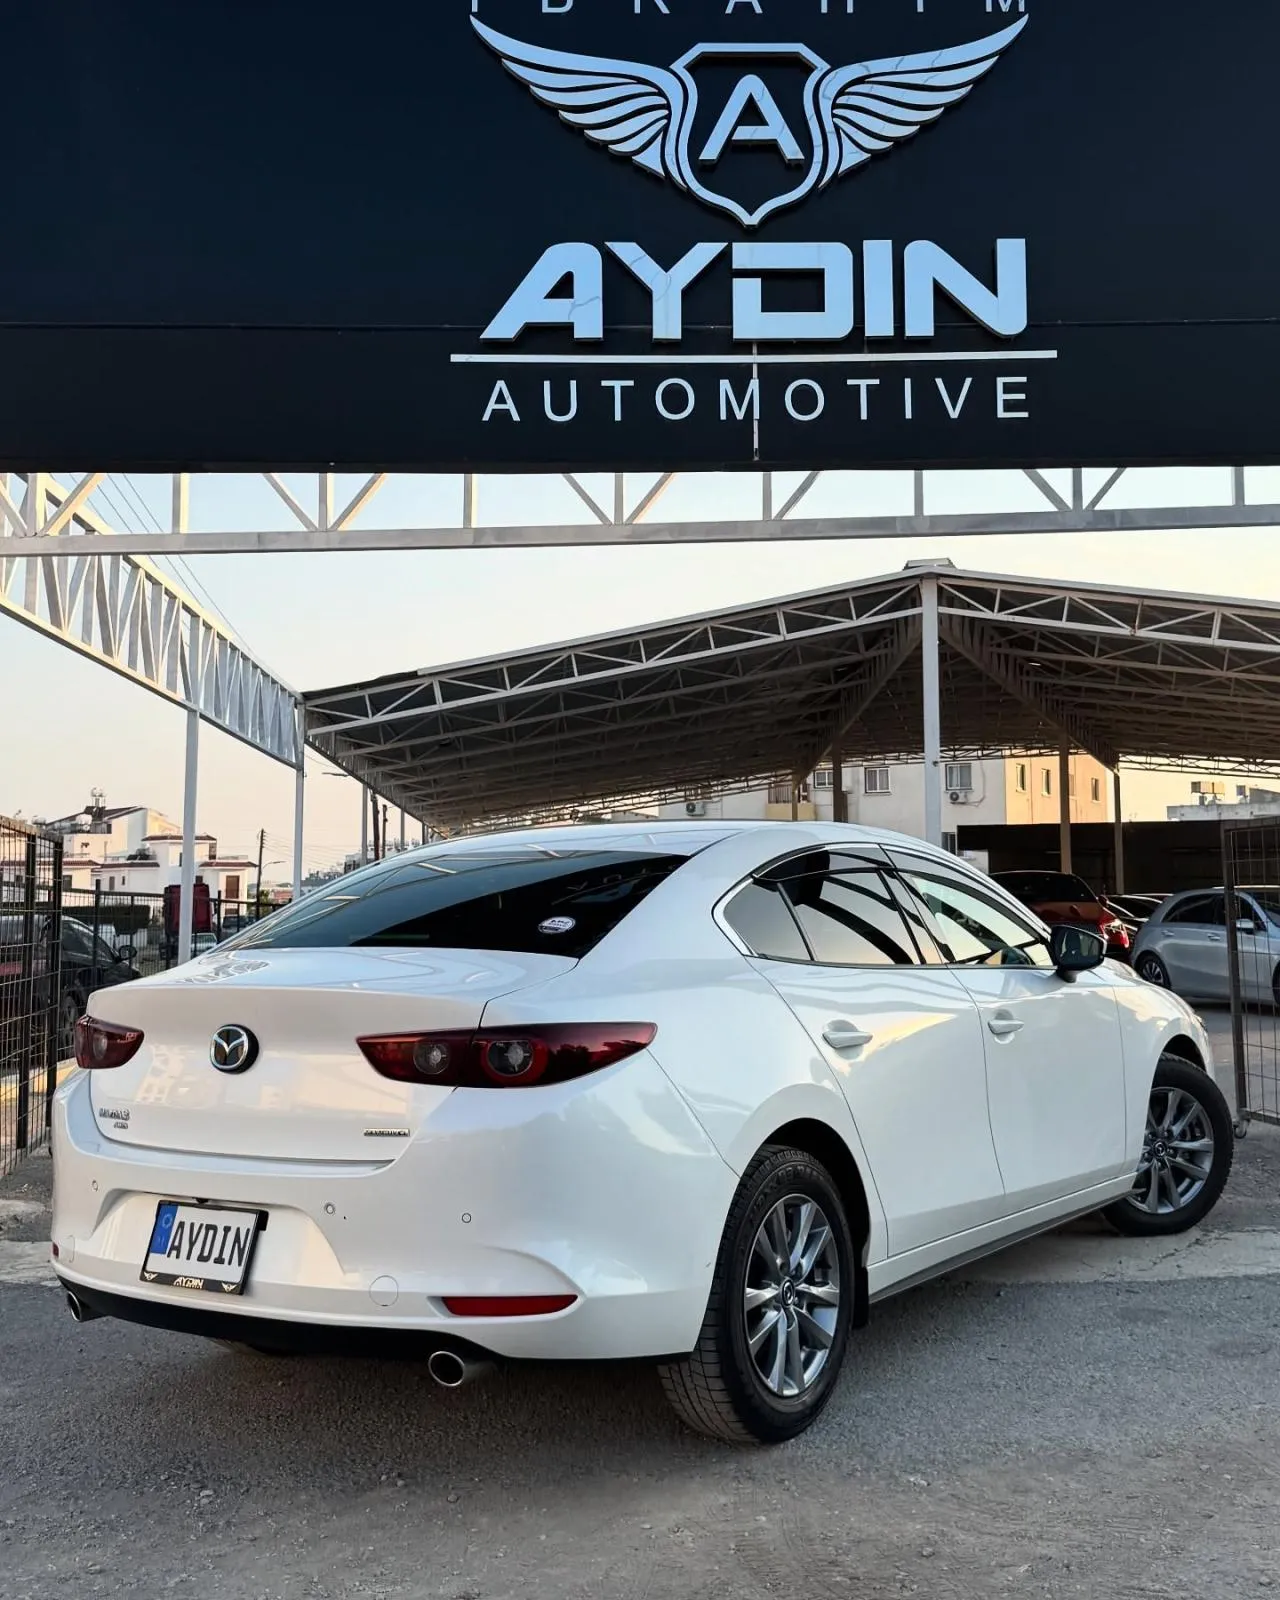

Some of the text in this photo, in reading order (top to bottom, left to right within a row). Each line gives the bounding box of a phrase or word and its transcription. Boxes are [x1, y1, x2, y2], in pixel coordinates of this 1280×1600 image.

[698, 74, 805, 162] A
[480, 238, 1028, 340] AYDIN
[482, 377, 1029, 421] AUTOMOTIVE
[167, 1220, 251, 1267] AYDIN
